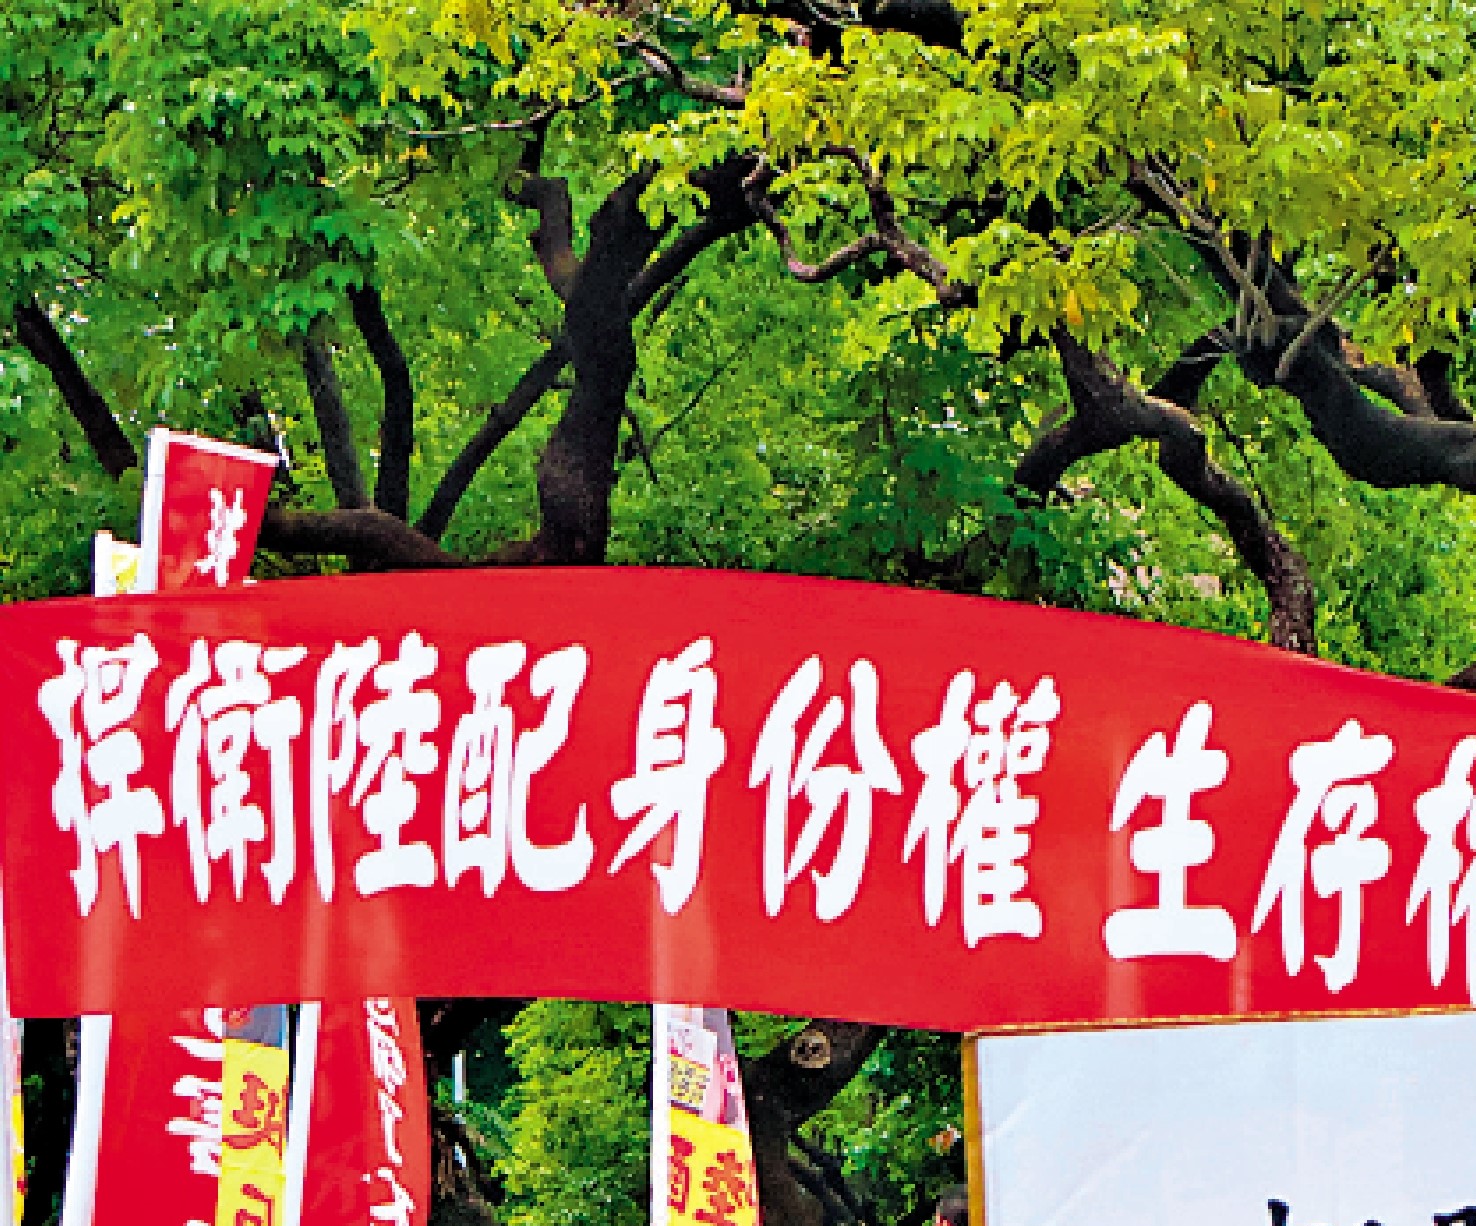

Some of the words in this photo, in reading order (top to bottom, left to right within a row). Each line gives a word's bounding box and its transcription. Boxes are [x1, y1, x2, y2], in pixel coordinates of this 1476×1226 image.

[37, 632, 1062, 949] 捍衛陸配身份權
